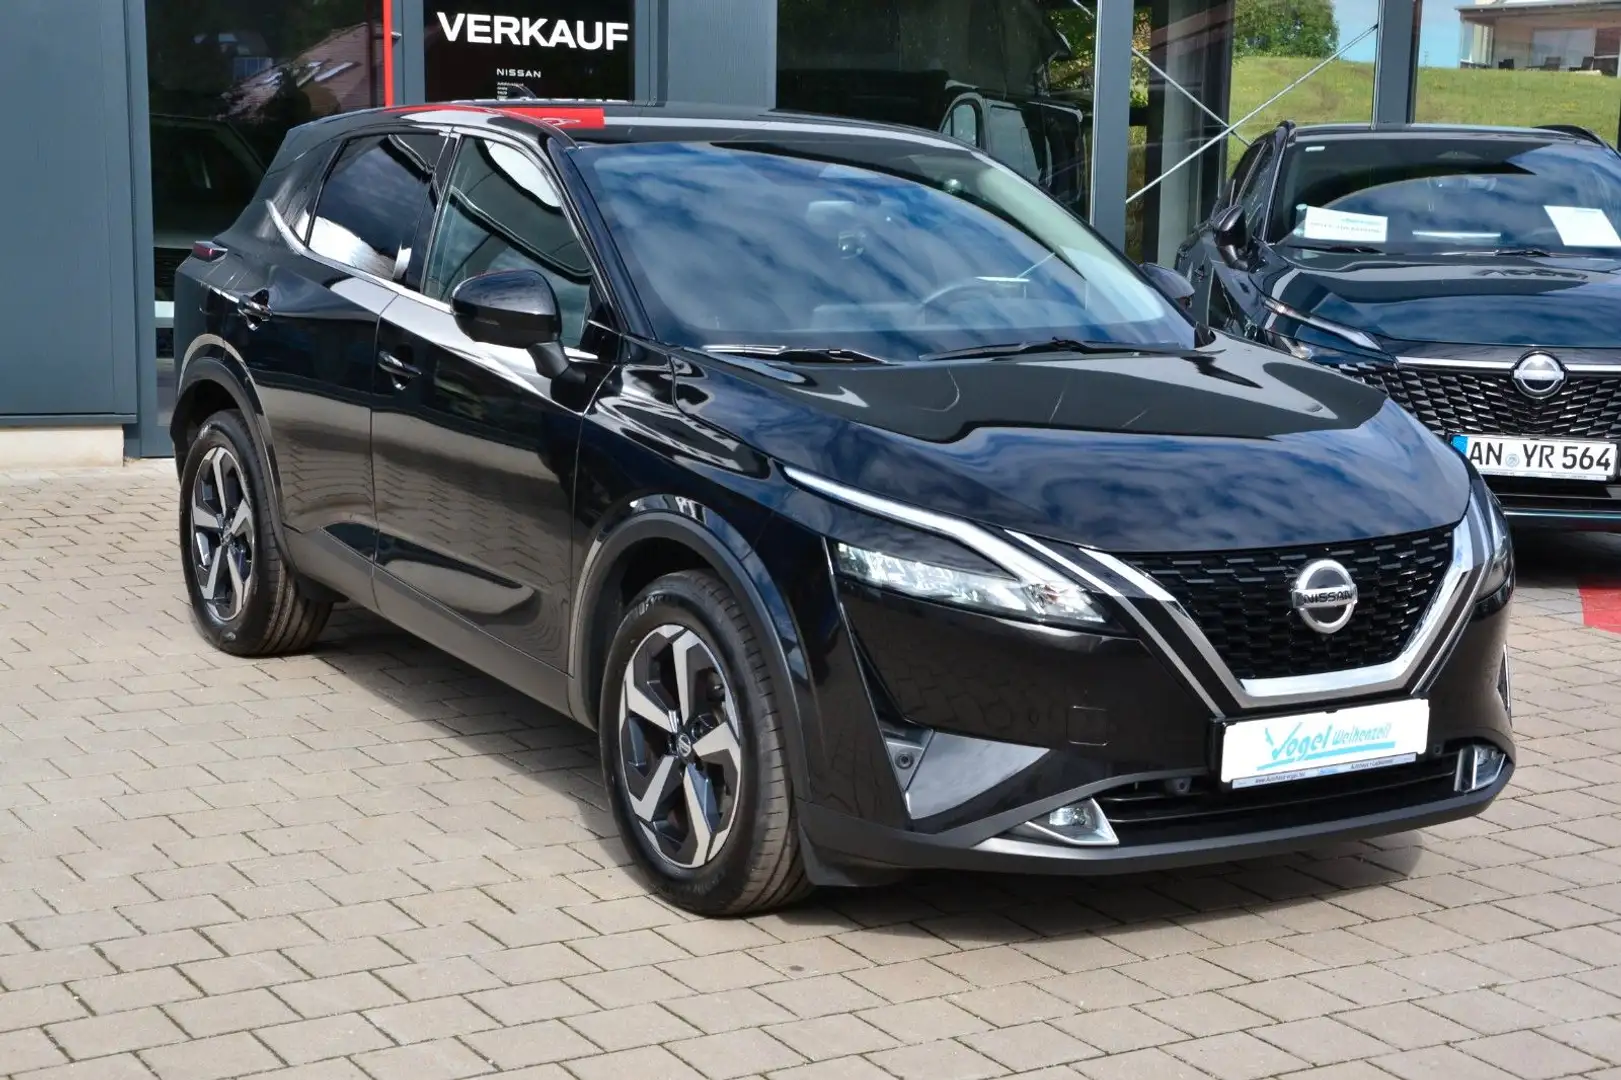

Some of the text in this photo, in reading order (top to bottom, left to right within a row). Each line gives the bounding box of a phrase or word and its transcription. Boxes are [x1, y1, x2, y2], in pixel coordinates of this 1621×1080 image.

[436, 11, 629, 51] VERKAUF
[496, 68, 542, 78] NISSAN
[1469, 441, 1611, 471] AN YR 564
[1303, 590, 1353, 604] NISSAN
[1265, 722, 1334, 761] Vogel
